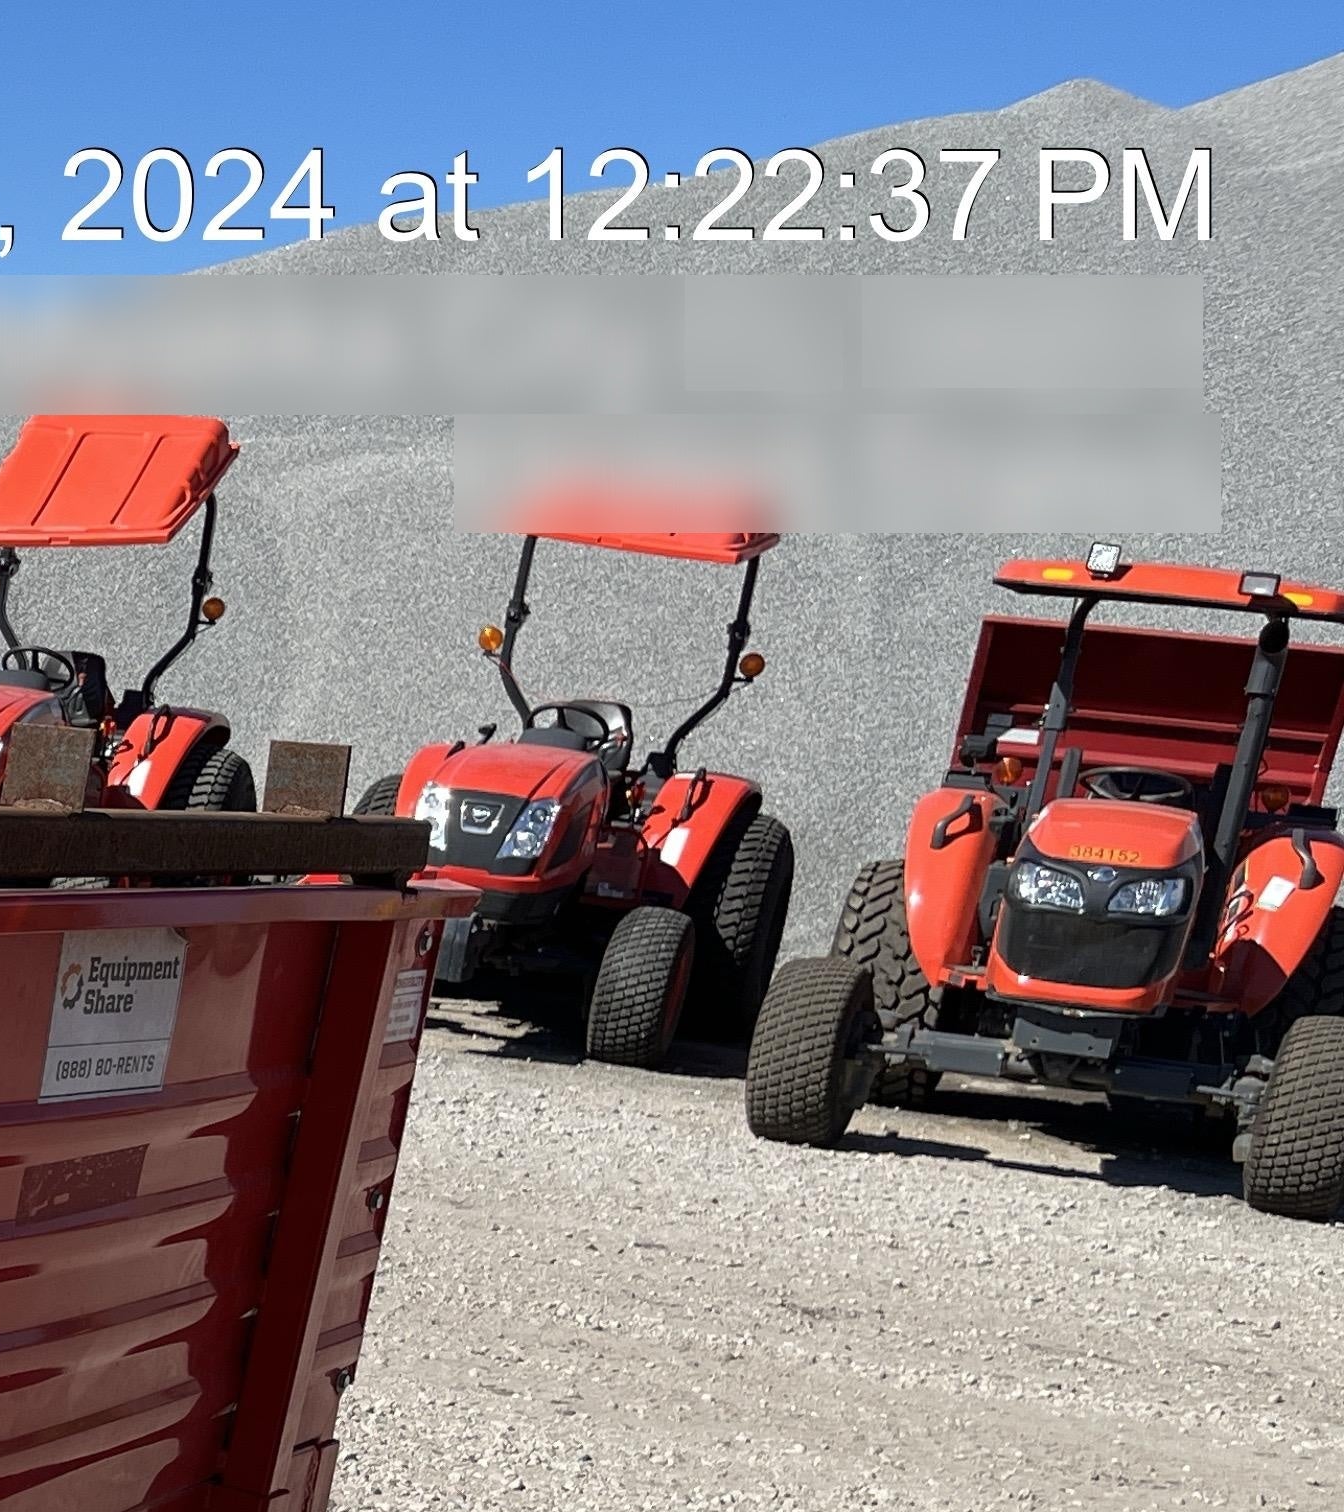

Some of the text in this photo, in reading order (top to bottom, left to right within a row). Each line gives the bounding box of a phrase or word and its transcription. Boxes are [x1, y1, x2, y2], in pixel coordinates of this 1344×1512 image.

[1071, 845, 1140, 863] 384152
[88, 955, 180, 988] Equipment
[83, 989, 134, 1014] Share
[55, 1054, 156, 1082] (888) 80-RENTS
